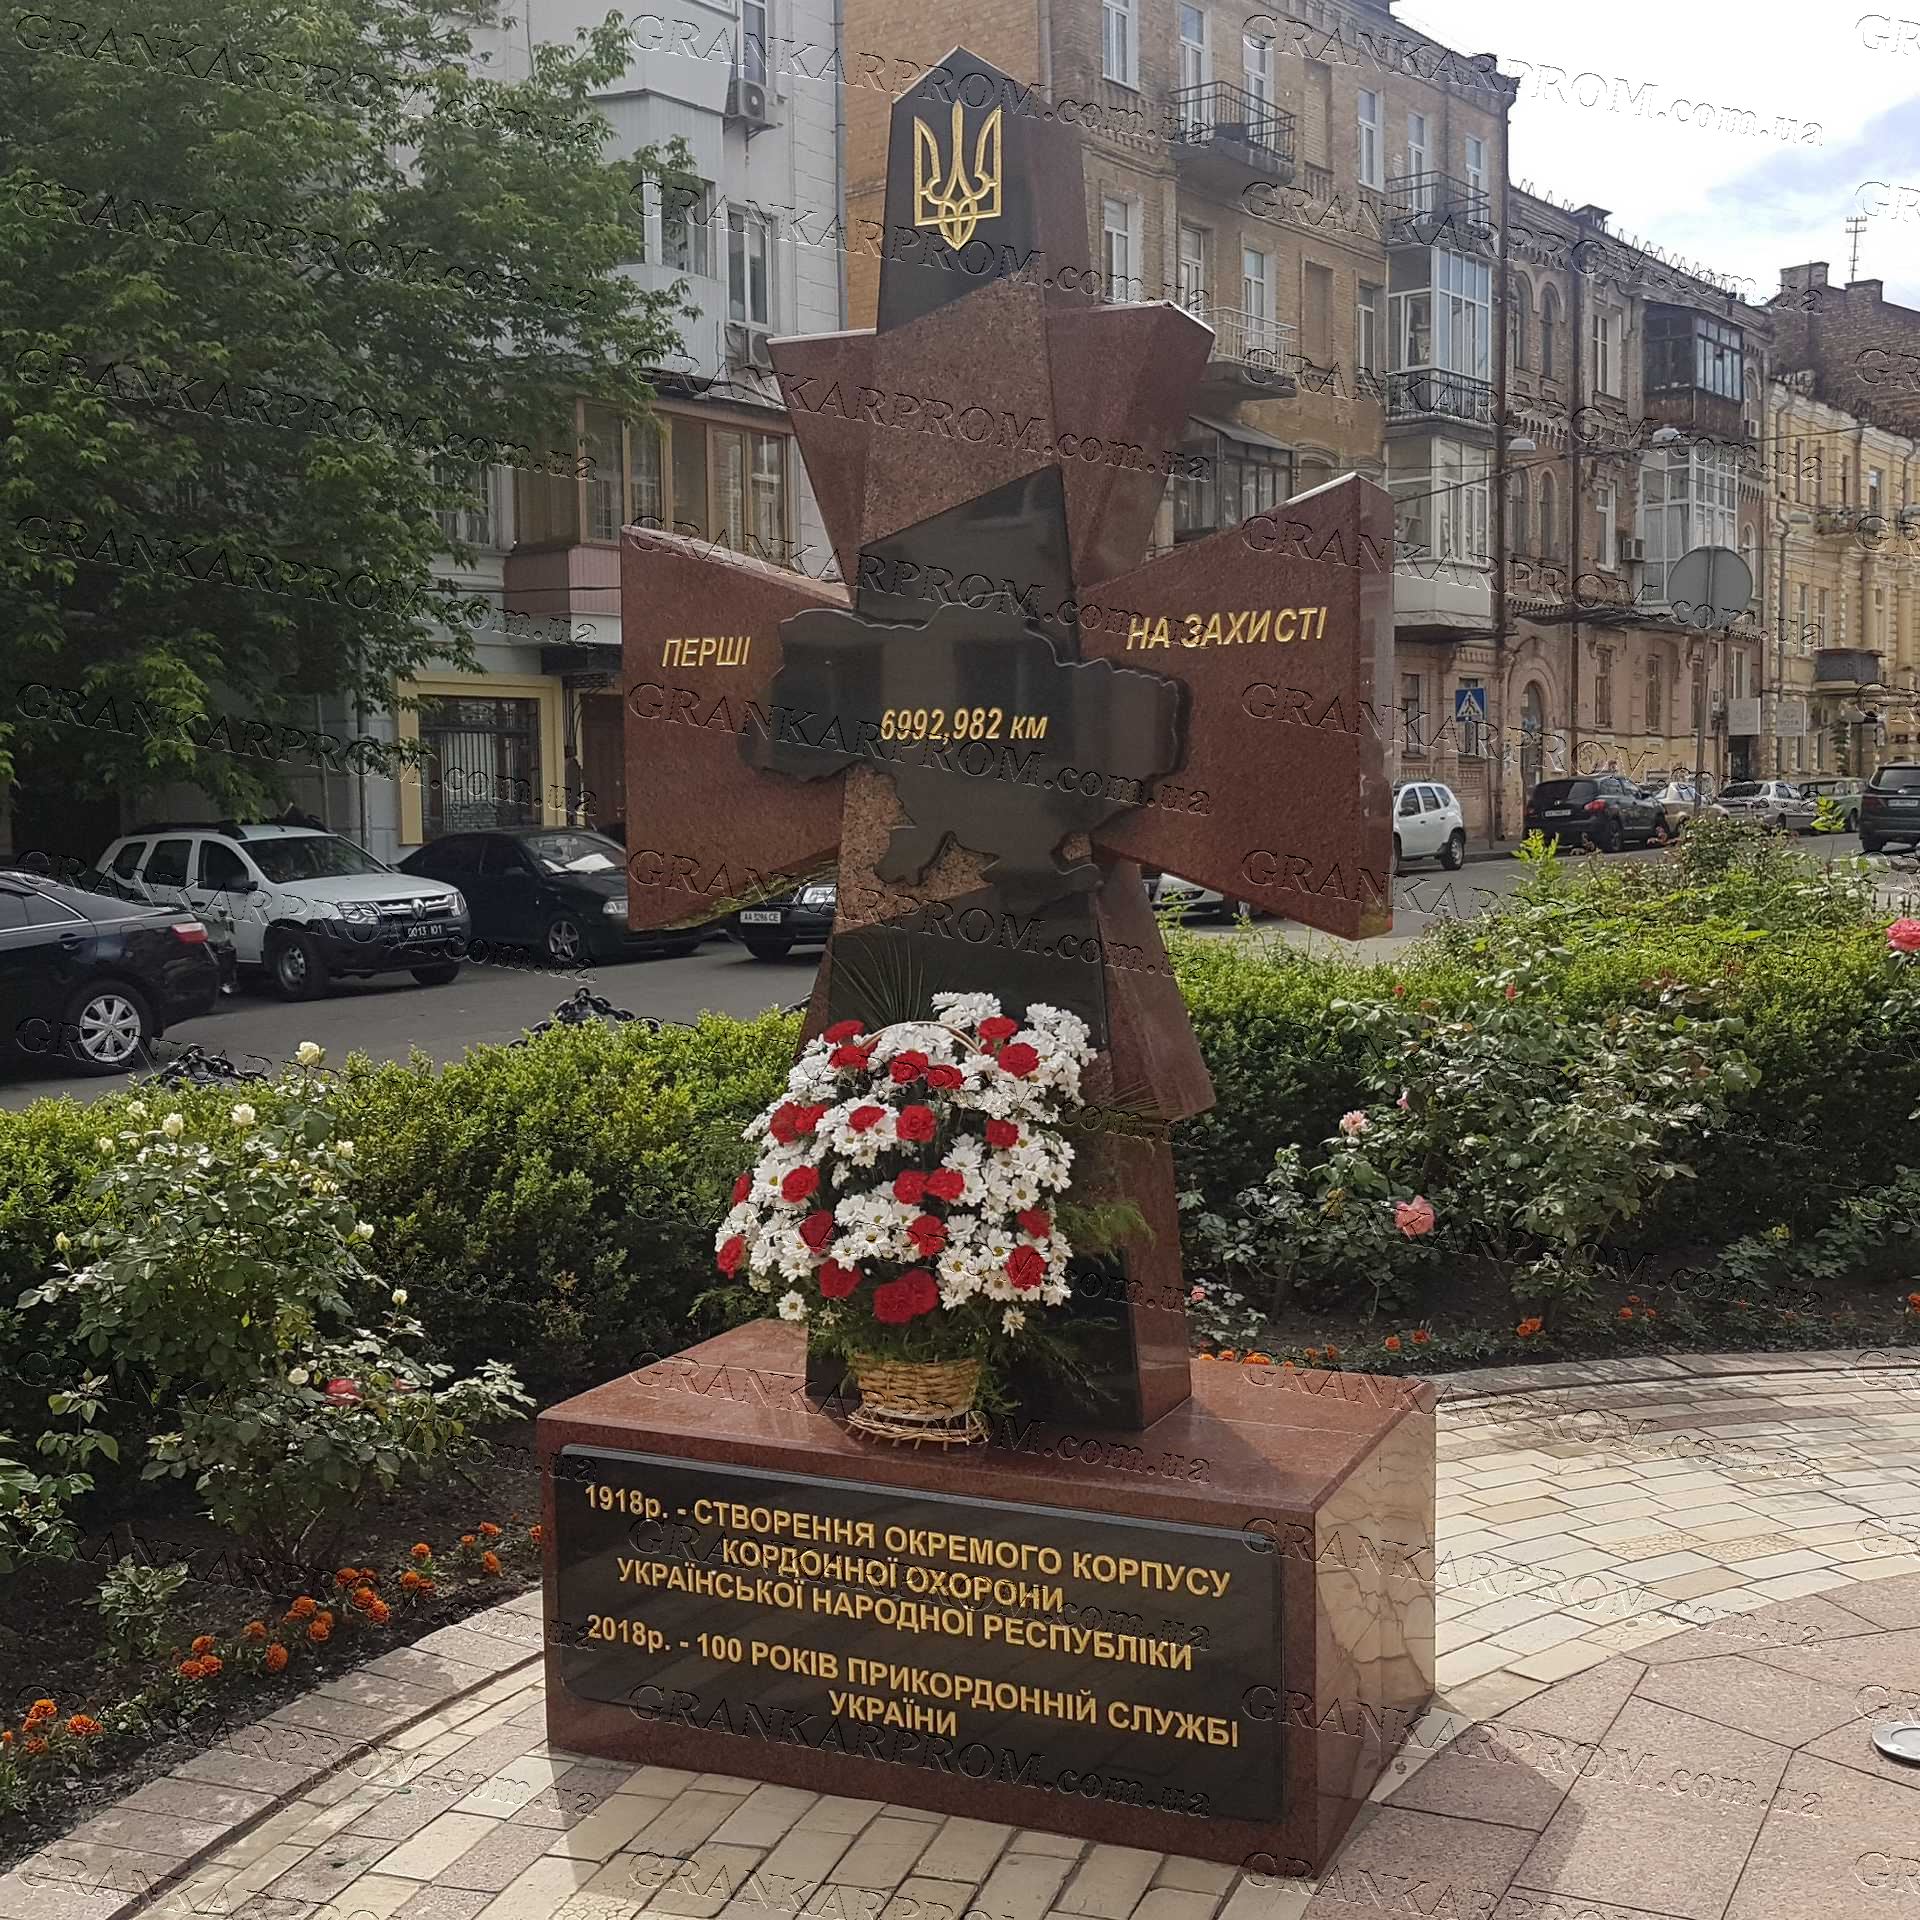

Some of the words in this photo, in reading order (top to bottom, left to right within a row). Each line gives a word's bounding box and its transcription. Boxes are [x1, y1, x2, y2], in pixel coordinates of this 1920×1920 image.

[662, 636, 751, 667] ПЕРШІ
[1126, 617, 1170, 650] НА
[1181, 606, 1328, 648] ЗАХИСТІ
[880, 707, 1002, 745] 6992,982
[585, 1484, 669, 1519] 1918р.
[694, 1499, 876, 1550] СТВОРЕННЯ
[885, 1526, 1062, 1576] ОКРЕМОГО
[1072, 1552, 1231, 1598] КОРПУСУ
[722, 1538, 898, 1590] КОРДОННОЇ
[905, 1565, 1064, 1613] ОХОРОНИ
[617, 1557, 804, 1610] УКРАЇНСЬКОЇ
[813, 1587, 974, 1637] НАРОДНОЇ
[983, 1614, 1192, 1671] РЕСПУБЛІКИ
[587, 1614, 671, 1653] 2018р.
[697, 1632, 743, 1663] 100
[751, 1641, 839, 1679] РОКІВ
[847, 1657, 1097, 1724] ПРИКОРДОННІЙ
[1107, 1701, 1239, 1748] СЛУЖБІ
[828, 1689, 958, 1737] УКРАЇНИ
